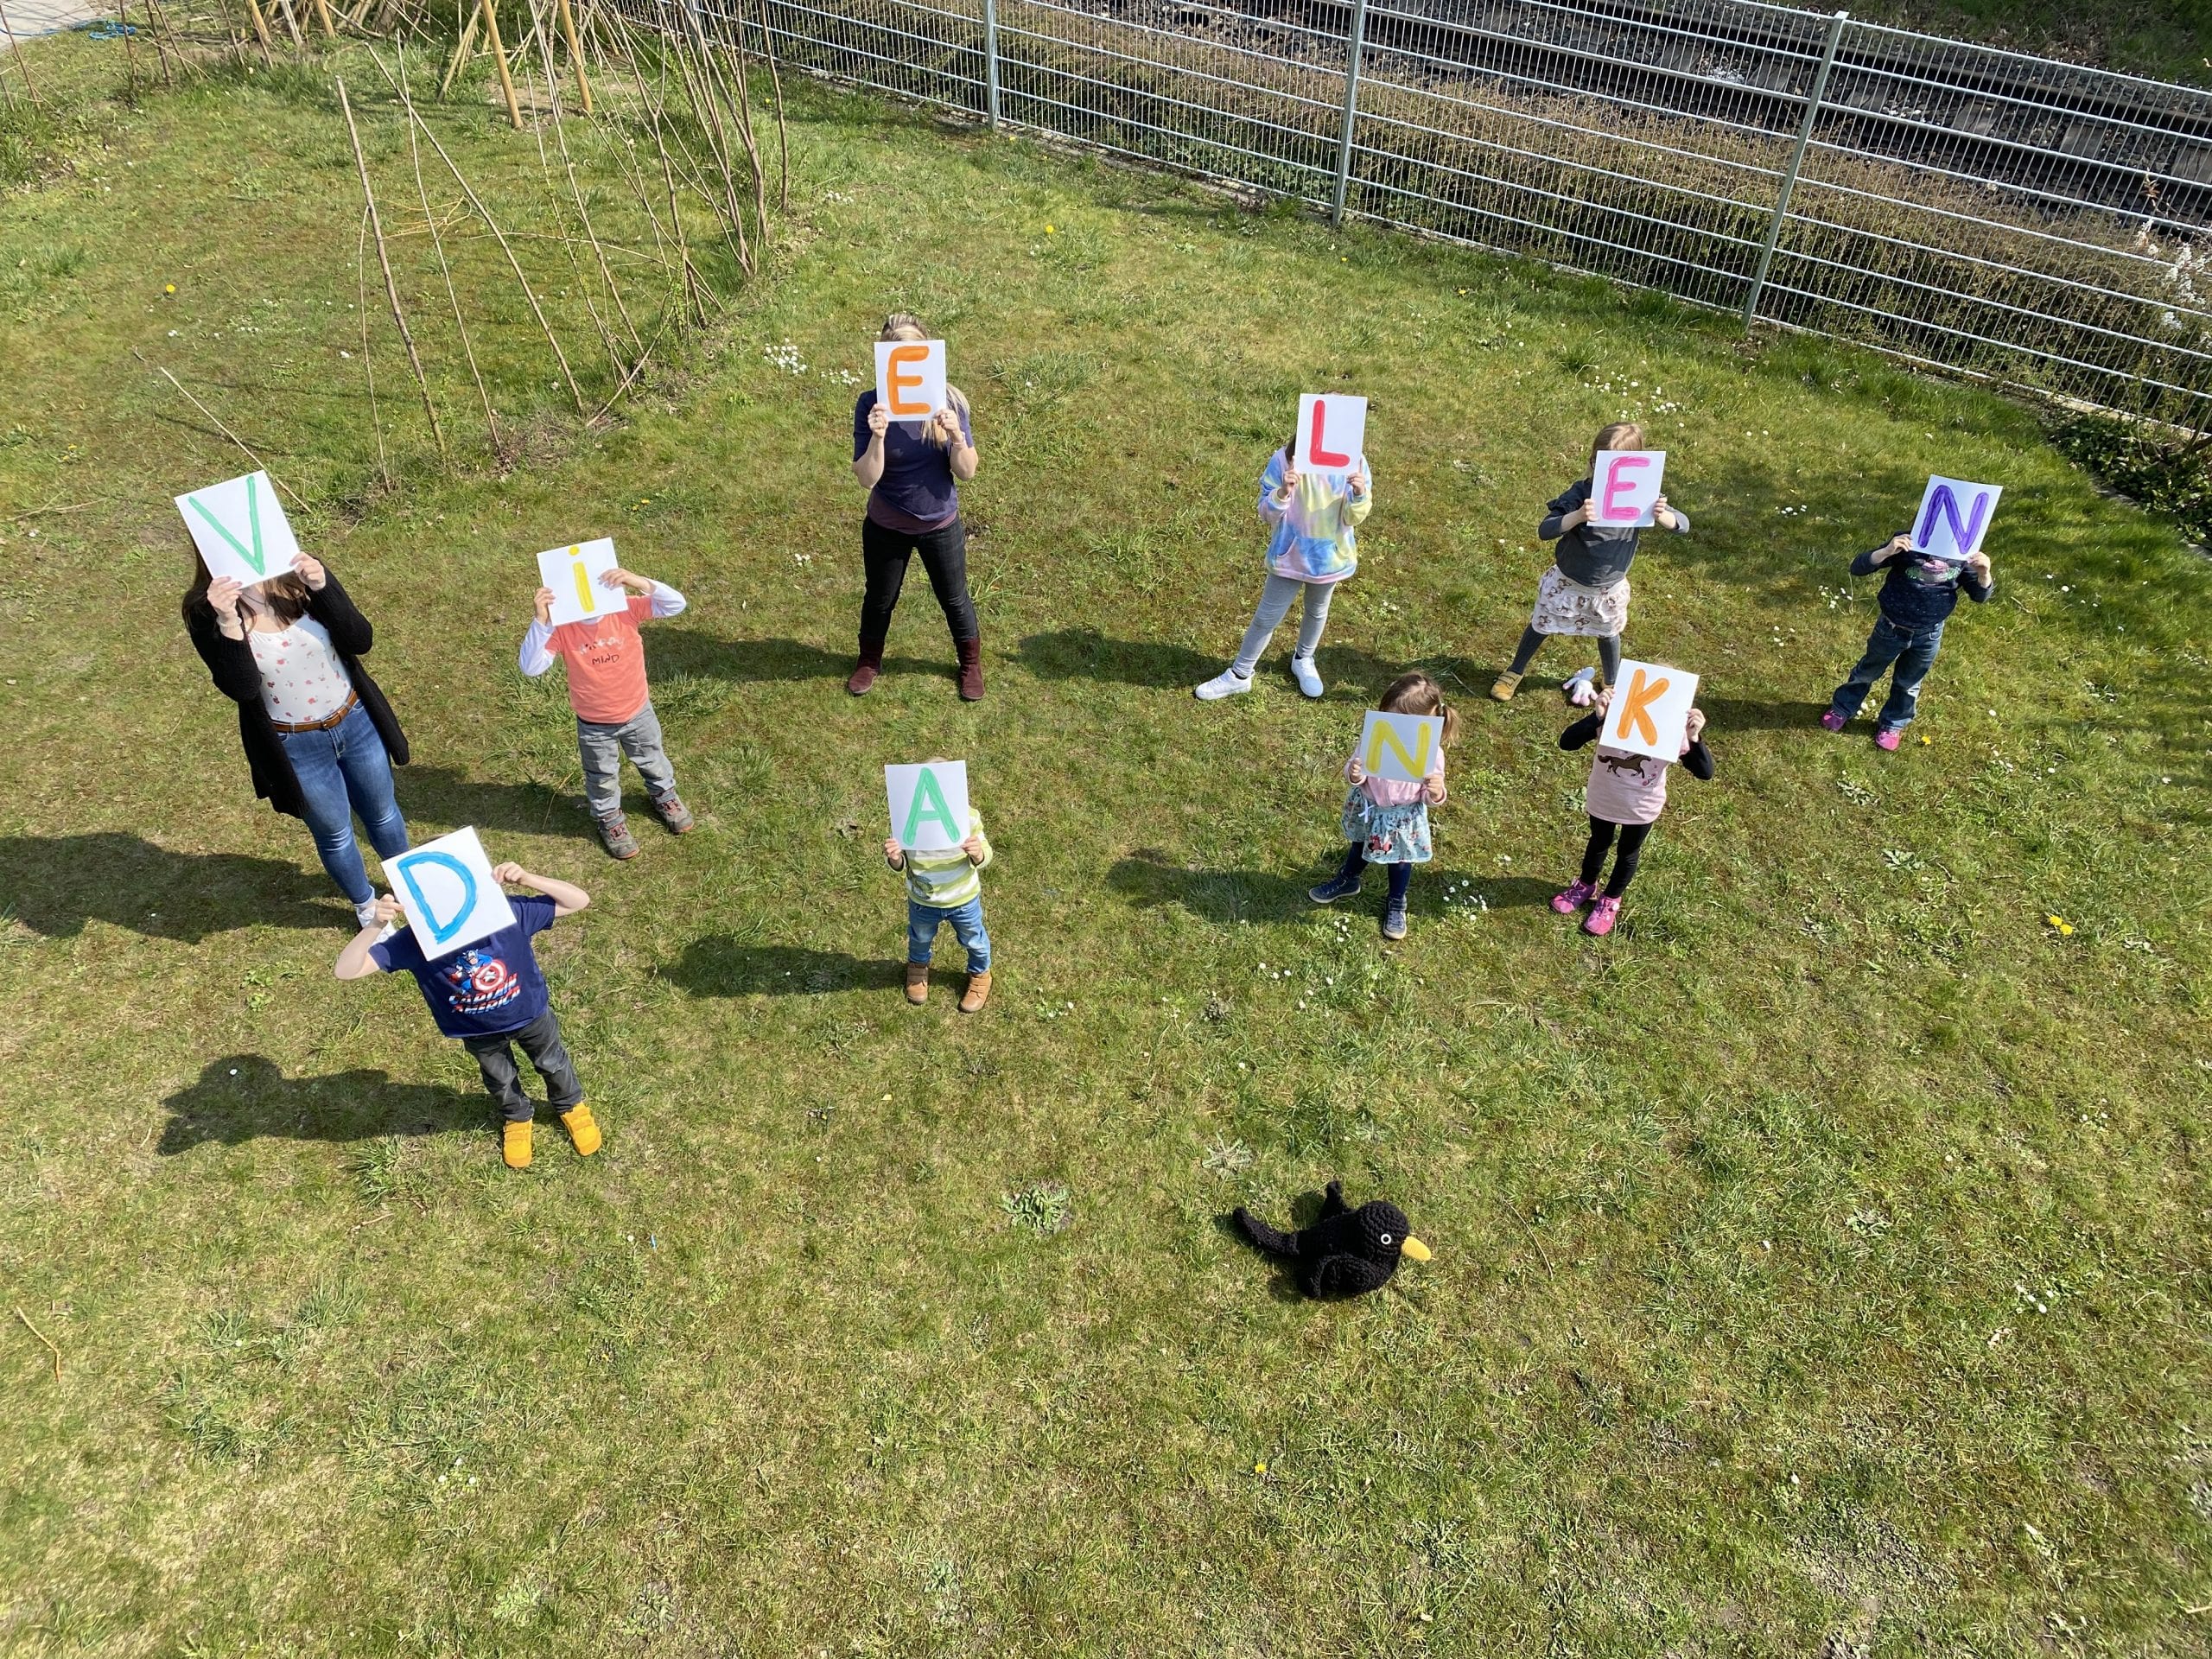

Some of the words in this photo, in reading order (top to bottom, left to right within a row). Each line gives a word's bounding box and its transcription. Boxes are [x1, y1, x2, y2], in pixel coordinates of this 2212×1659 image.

[887, 345, 931, 416] E
[1309, 400, 1351, 467] L
[1602, 456, 1651, 520] E
[1917, 484, 1989, 554] N
[188, 475, 265, 575] V
[568, 545, 595, 613] i
[592, 653, 620, 665] MIND
[1617, 669, 1670, 747] K
[1366, 721, 1432, 779] N
[903, 767, 960, 846] A
[397, 851, 477, 944] D
